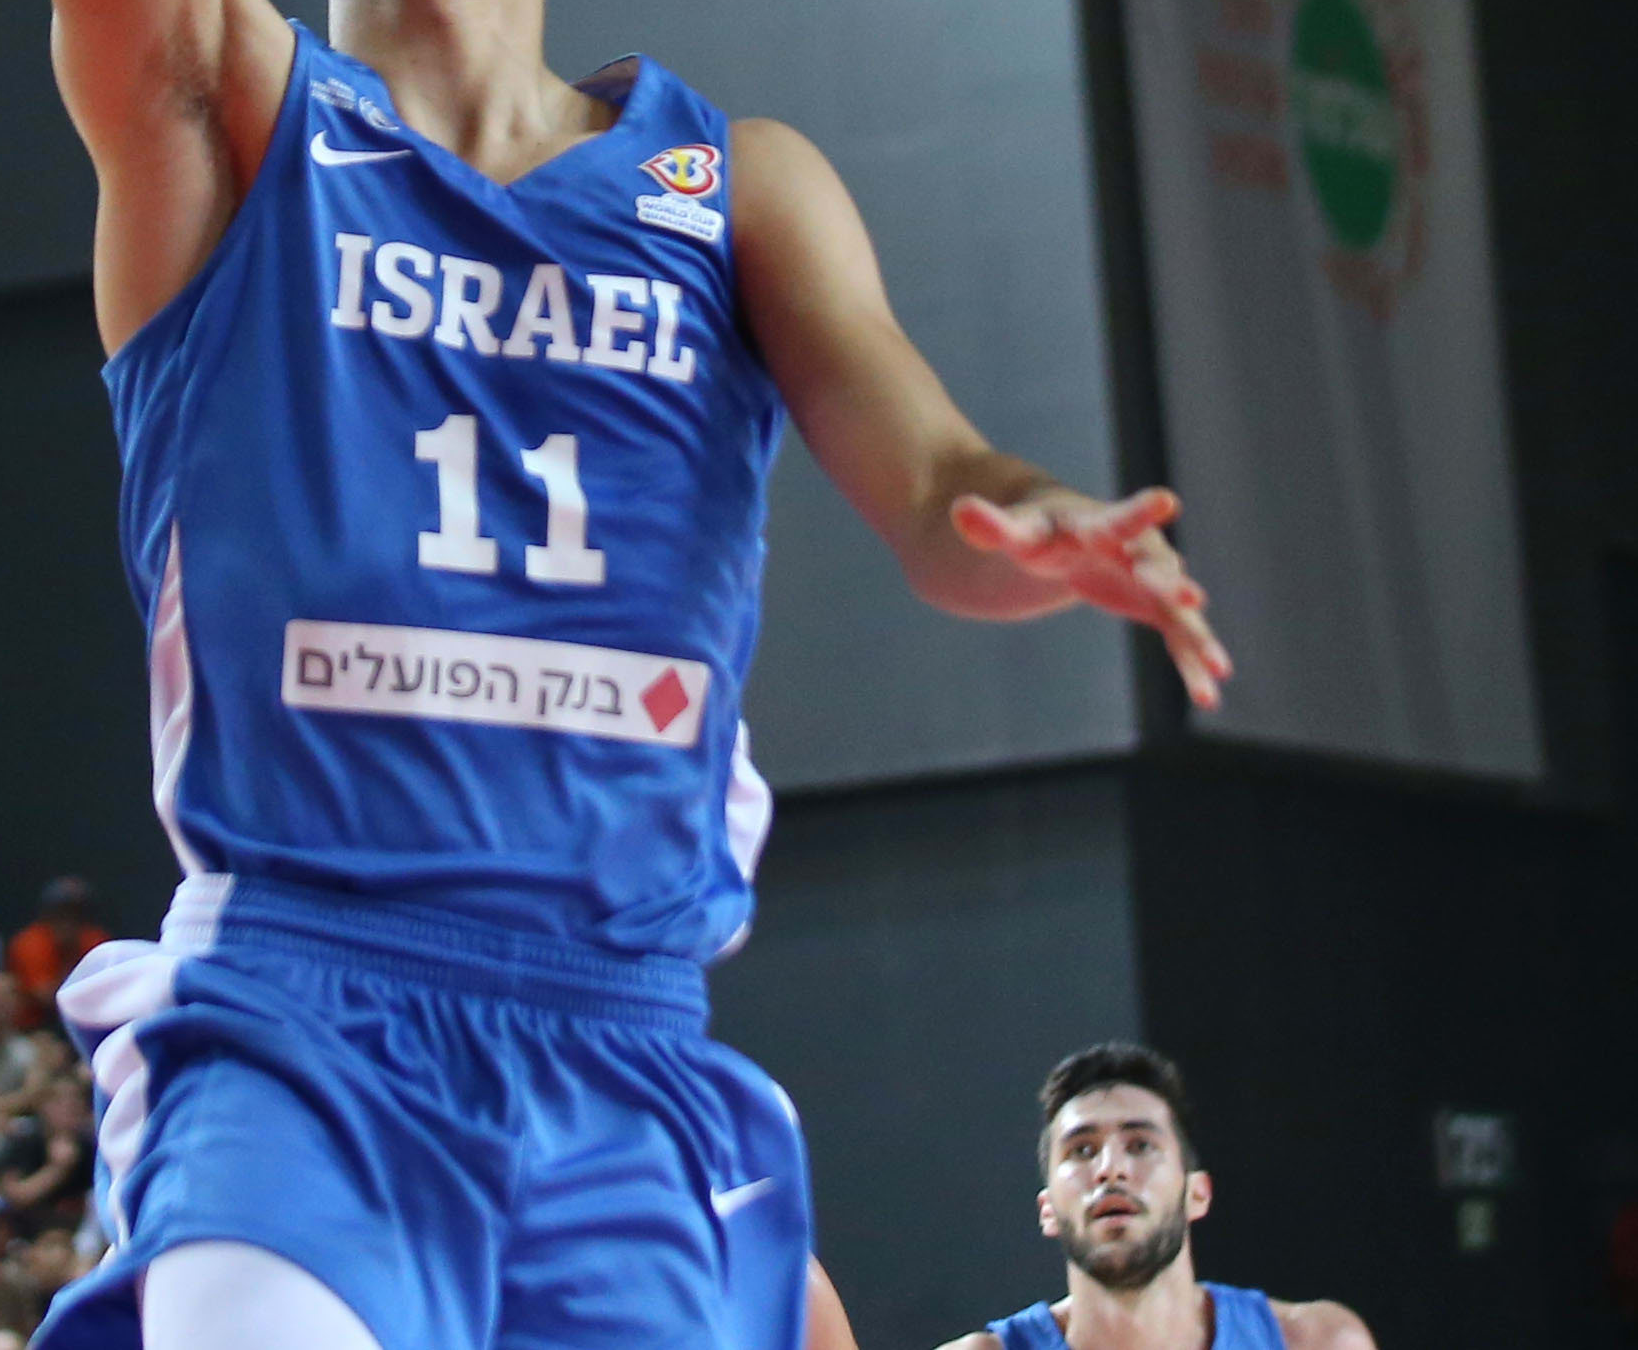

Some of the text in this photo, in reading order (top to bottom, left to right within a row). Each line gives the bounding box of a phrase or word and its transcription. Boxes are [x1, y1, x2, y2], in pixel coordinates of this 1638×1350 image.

[330, 232, 696, 384] ISRAEL
[414, 413, 606, 587] 11
[297, 641, 623, 717] בנק הפועלים
